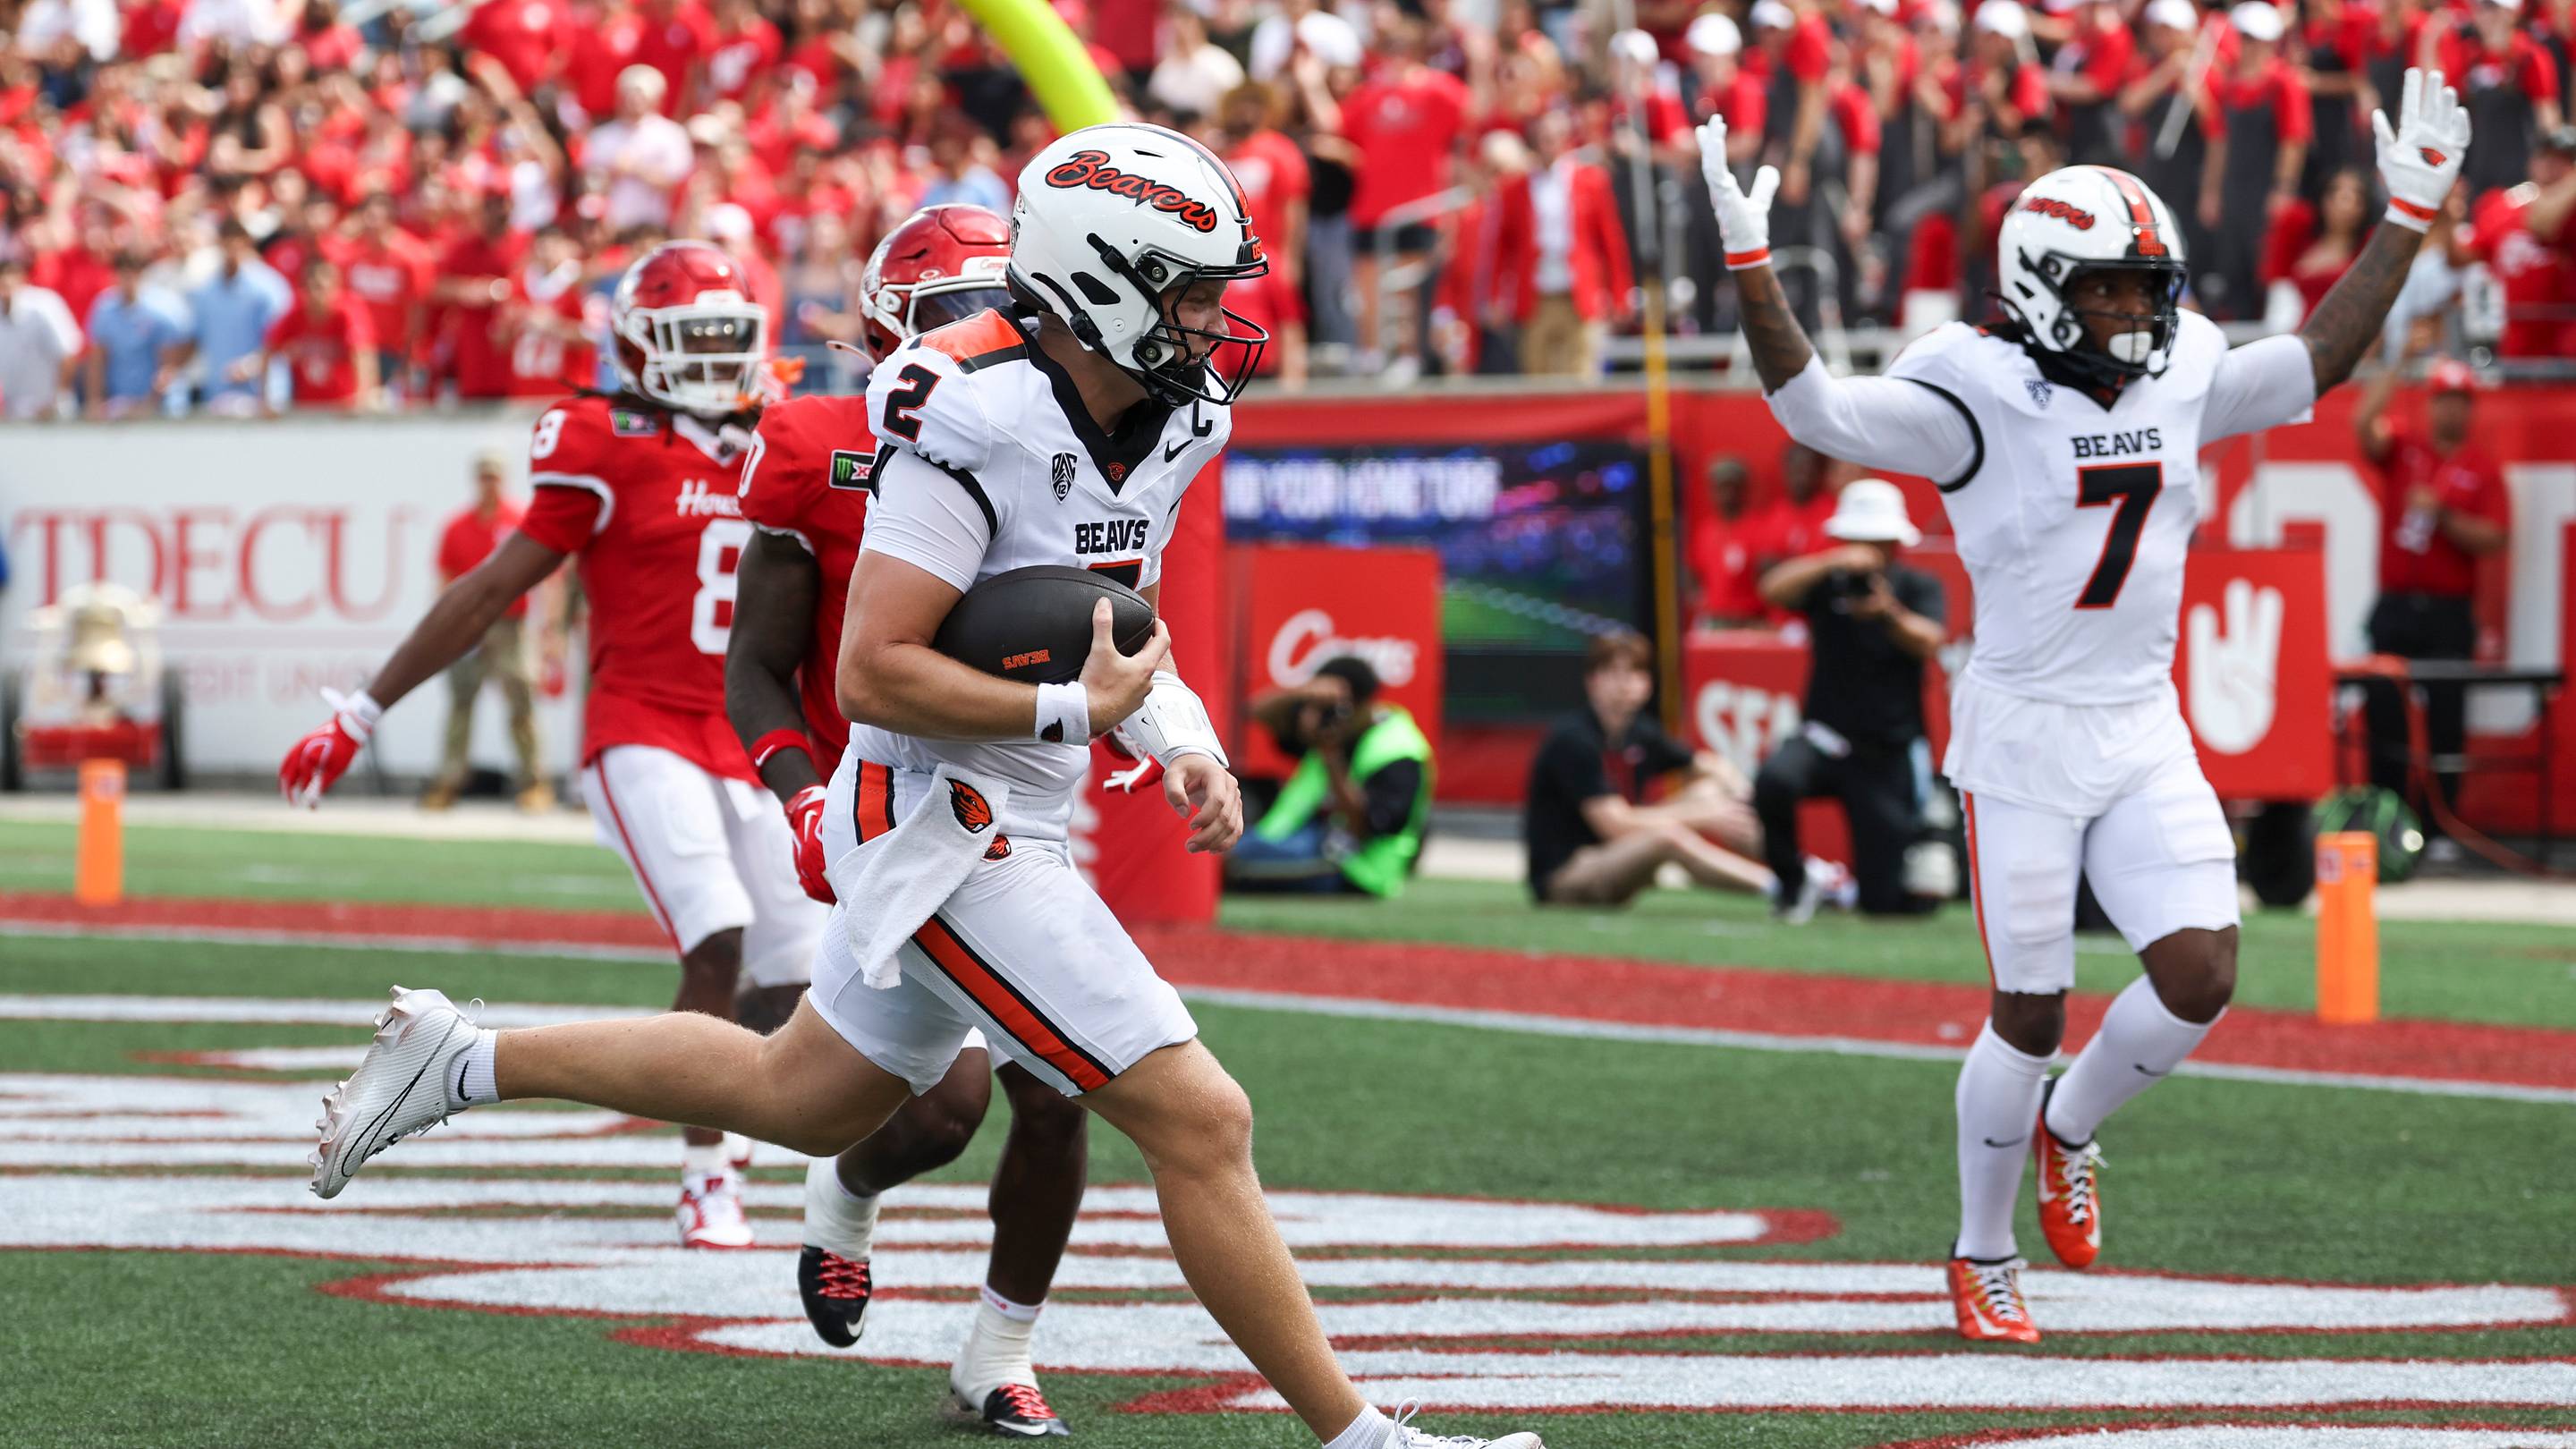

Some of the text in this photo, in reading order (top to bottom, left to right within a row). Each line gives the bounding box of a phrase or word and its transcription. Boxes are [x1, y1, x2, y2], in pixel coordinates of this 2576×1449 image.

[1045, 149, 1217, 233] Beavers
[882, 362, 942, 444] 2
[2072, 428, 2163, 458] BEAVS
[1057, 484, 1067, 495] 12
[13, 504, 419, 623] TDECU
[1075, 520, 1149, 554] BEAVS
[2072, 462, 2163, 610] 7
[690, 518, 756, 655] 8
[1002, 648, 1051, 670] BEAVS
